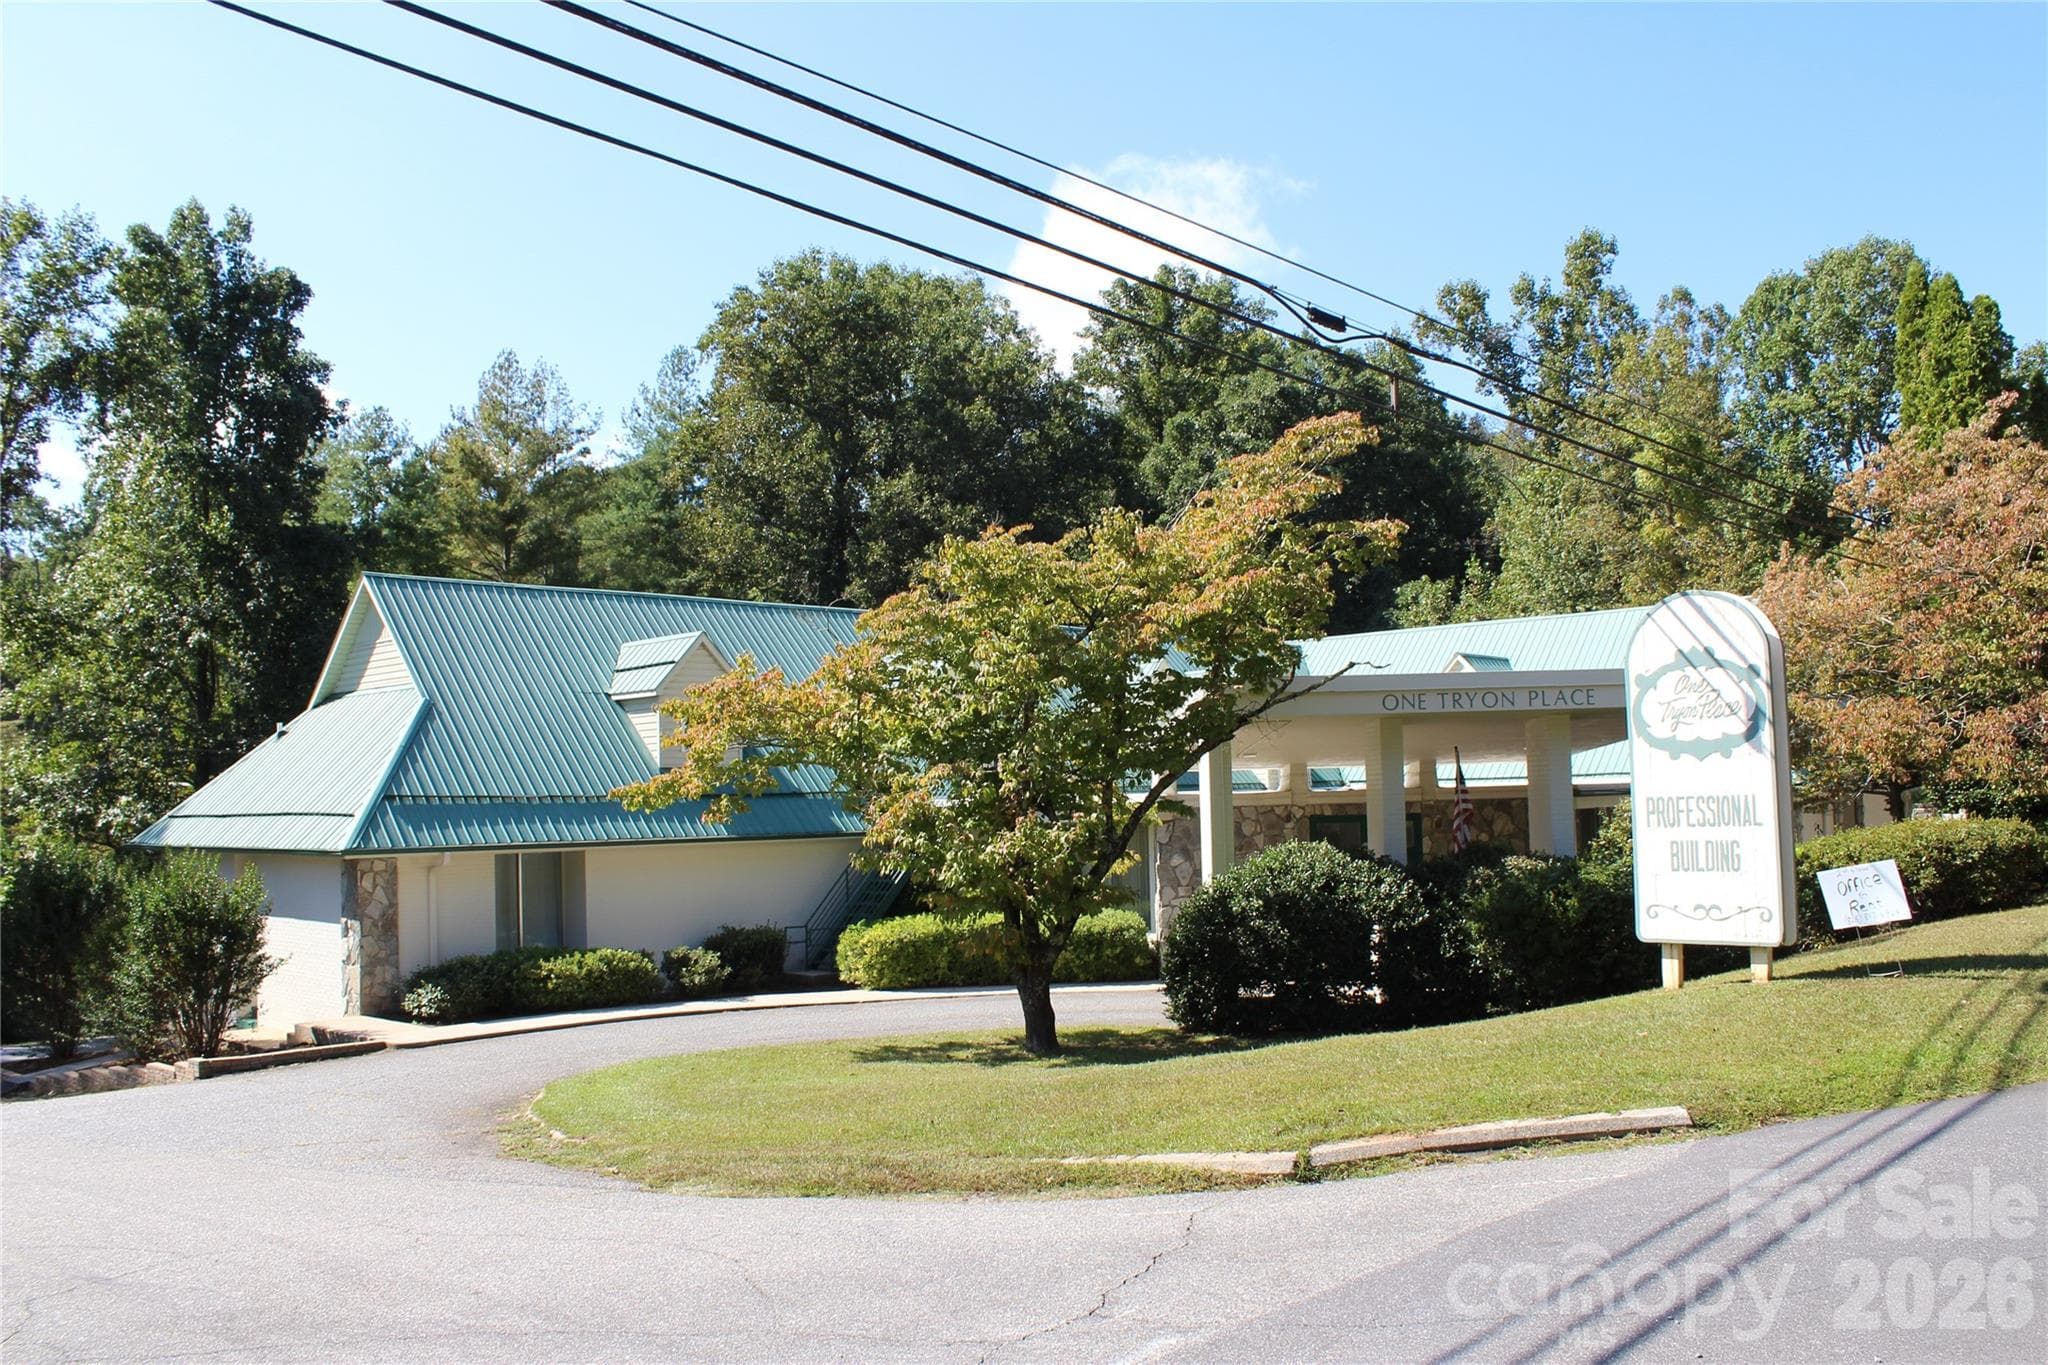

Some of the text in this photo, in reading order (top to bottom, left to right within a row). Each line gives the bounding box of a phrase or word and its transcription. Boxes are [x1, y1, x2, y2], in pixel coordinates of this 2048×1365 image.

[1382, 688, 1596, 711] ONE TRYON PLACE
[1674, 674, 1709, 695] One
[1658, 688, 1742, 732] Tryon Place
[1646, 795, 1763, 828] PROFESSIONAL
[1670, 840, 1741, 872] BUILDING
